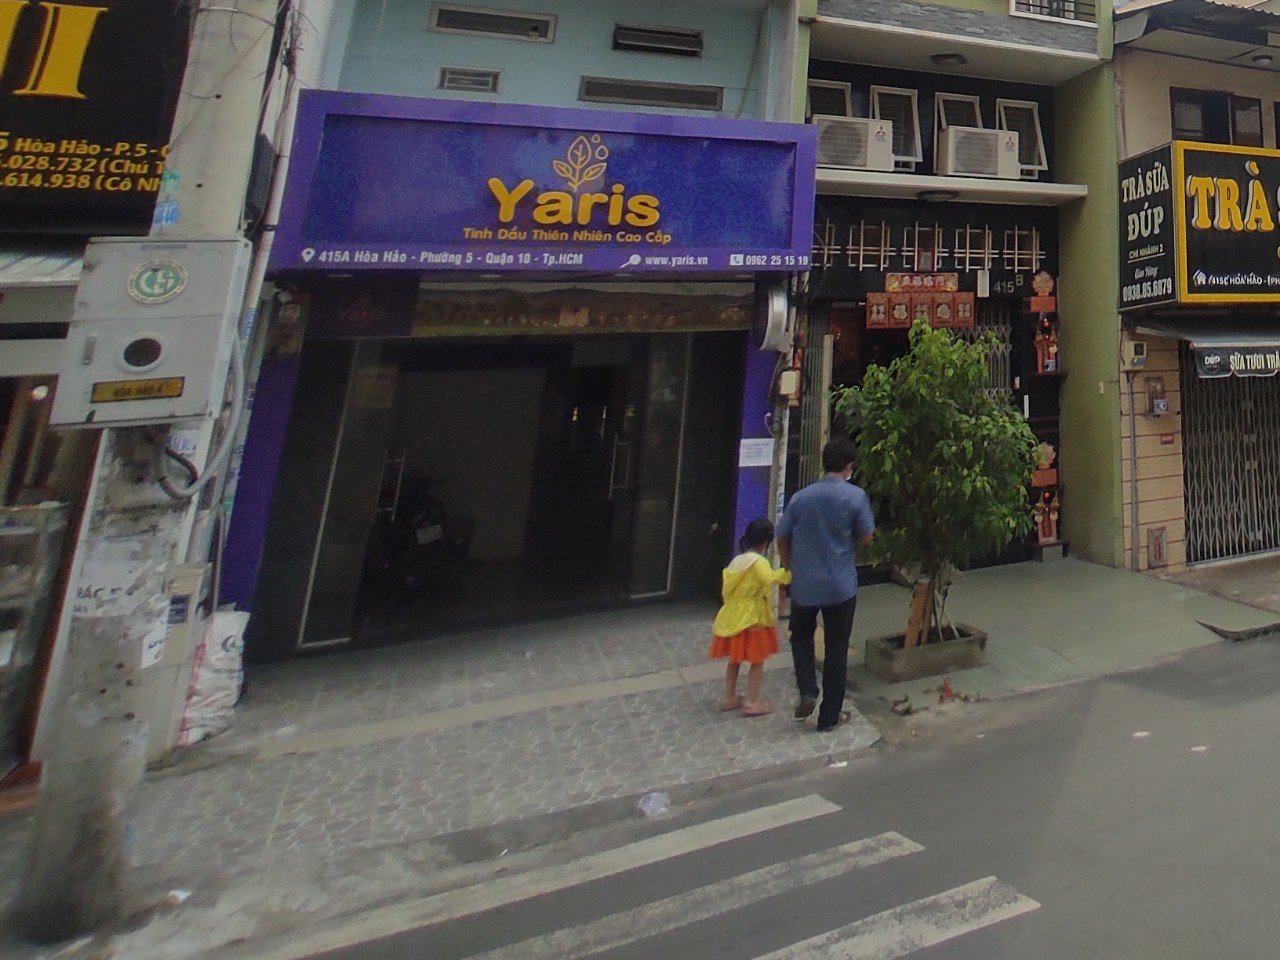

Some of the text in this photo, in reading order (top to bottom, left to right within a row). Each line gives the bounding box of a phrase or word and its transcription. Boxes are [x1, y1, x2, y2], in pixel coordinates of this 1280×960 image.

[15, 138, 55, 153] Hòa
[59, 140, 101, 155] Hảo
[0, 155, 97, 172] .028.732
[94, 175, 132, 191] (Cô
[1121, 161, 1169, 203] TRÀ SỮA
[487, 177, 661, 227] Yaris
[1187, 160, 1275, 232] TRÀ
[1127, 201, 1164, 241] ĐÚP
[497, 225, 527, 240] Dầu
[532, 229, 569, 241] Thiên
[573, 230, 612, 242] Nhiên
[616, 231, 641, 242] Cao
[645, 229, 671, 245] Cấp
[319, 250, 350, 262] 415A
[354, 250, 378, 263] Hòa
[383, 250, 407, 263] Hảo
[420, 250, 462, 265] Phường
[465, 252, 473, 264] 5
[485, 251, 513, 266] Quận
[518, 253, 531, 264] 10
[542, 253, 584, 266] Tp.HCM
[645, 255, 708, 267] www.yaris.vn
[746, 256, 809, 266] 0962 25 15 19
[1122, 277, 1172, 302] 0938.85.6879
[1229, 352, 1245, 370] SỮA
